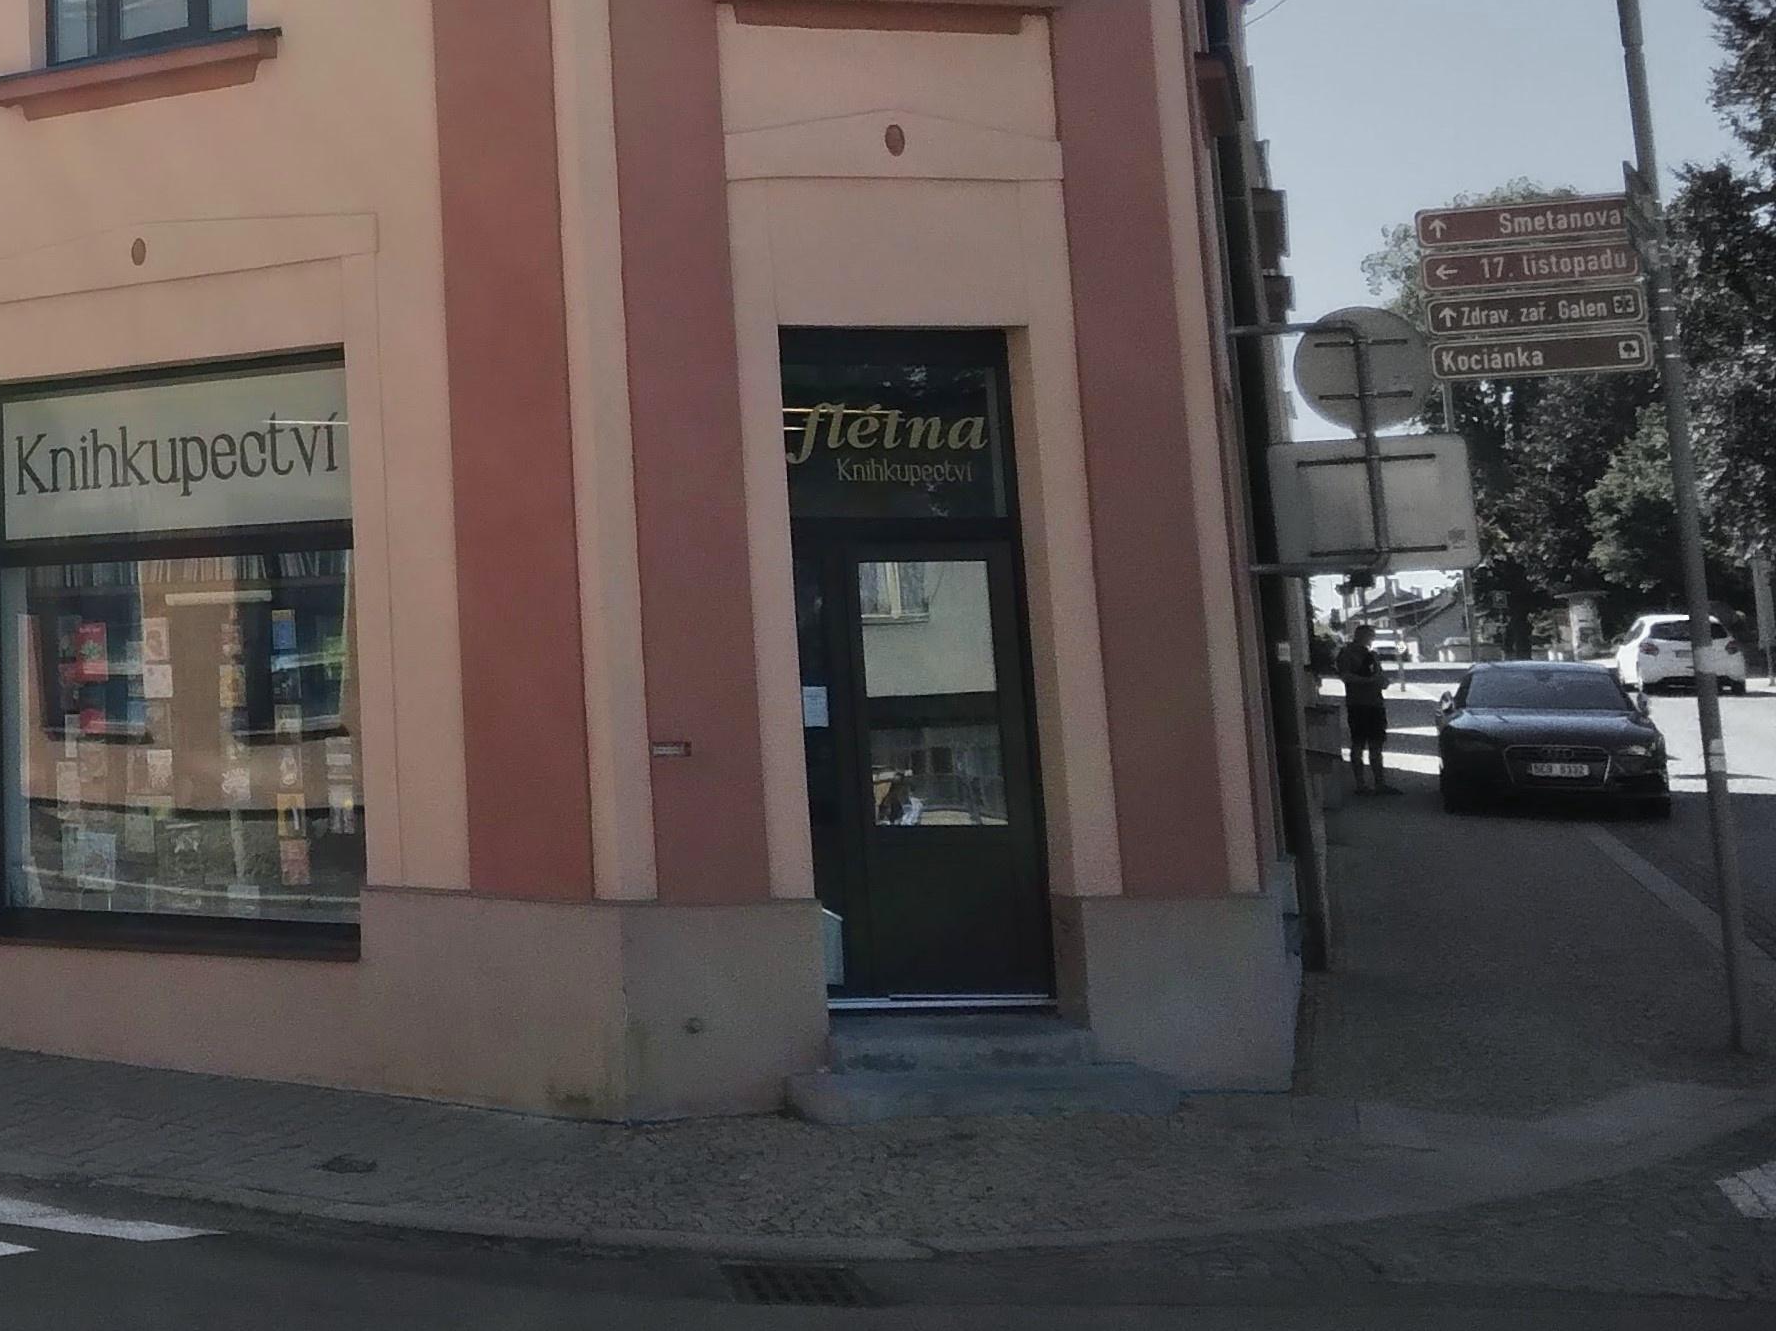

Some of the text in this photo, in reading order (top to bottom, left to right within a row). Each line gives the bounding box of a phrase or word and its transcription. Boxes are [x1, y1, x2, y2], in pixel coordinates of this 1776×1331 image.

[1498, 208, 1622, 235] Smetanova
[1479, 248, 1627, 279] 17. listopadu
[1460, 300, 1608, 327] Zdrav. zař. Galen
[1441, 346, 1545, 373] Kociánka
[785, 401, 989, 465] flétna
[14, 411, 339, 497] Knihkupectví
[836, 457, 974, 487] Knihkupectví
